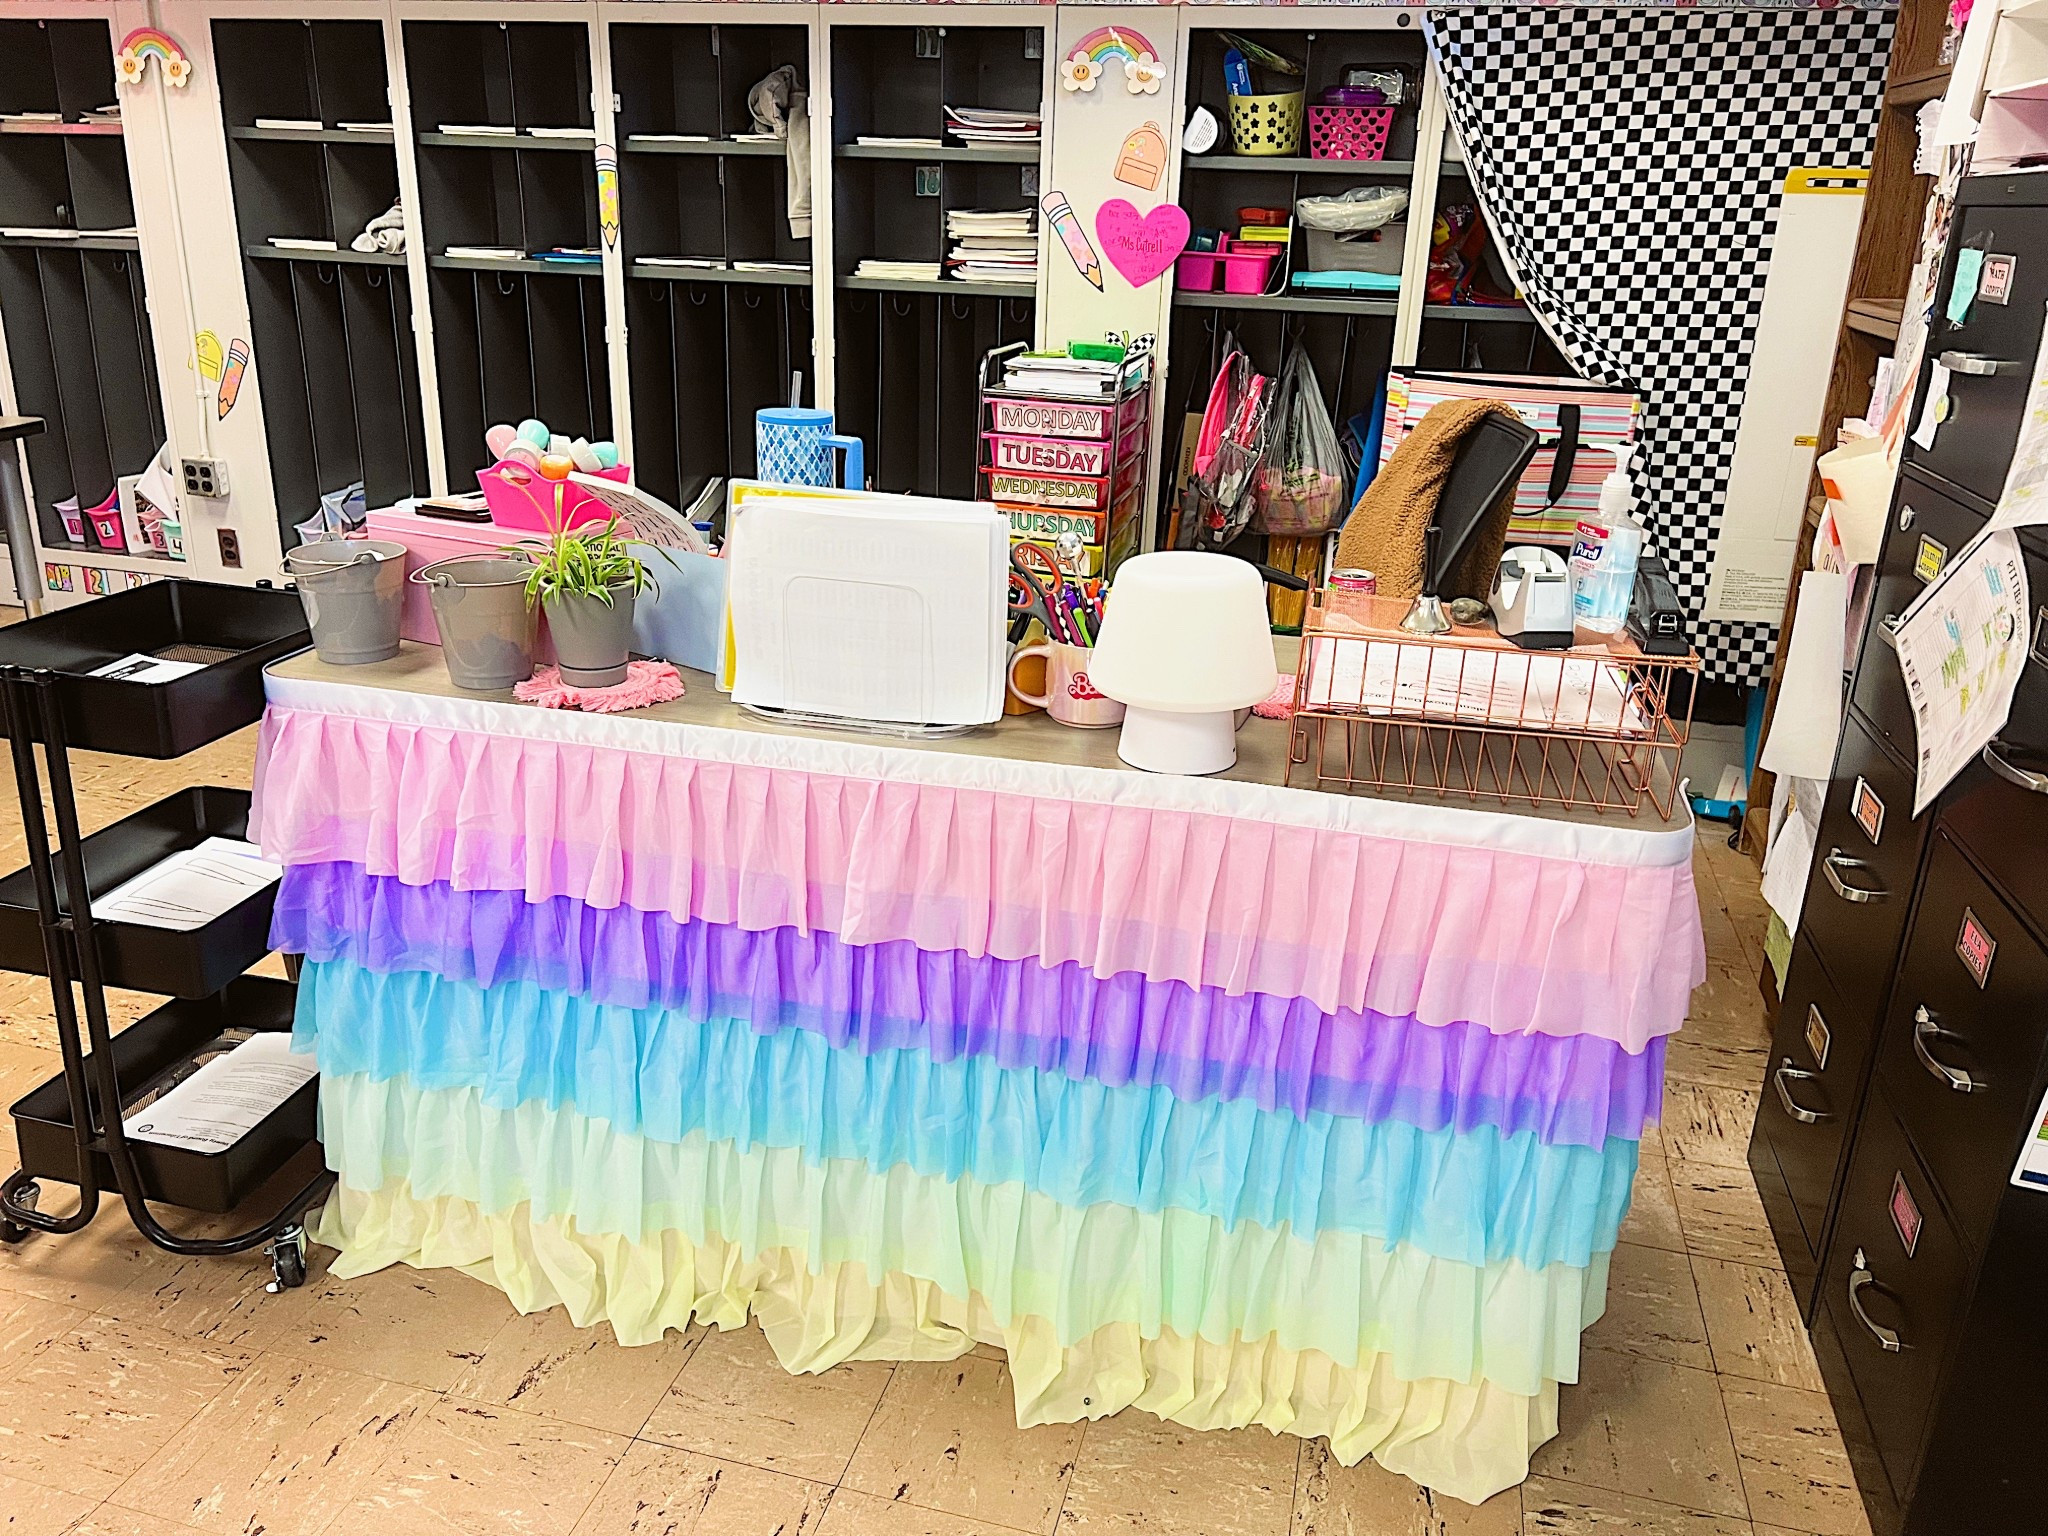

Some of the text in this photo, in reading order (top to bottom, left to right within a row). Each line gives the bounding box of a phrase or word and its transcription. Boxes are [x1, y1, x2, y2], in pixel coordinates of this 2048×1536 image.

[1001, 407, 1100, 431] MONDAY
[1002, 443, 1098, 473] TUESDAY
[992, 476, 1098, 500] WEDNESDAY
[100, 523, 111, 536] 2
[1575, 542, 1600, 560] Purell
[1970, 930, 1982, 951] ELA
[1962, 941, 1982, 972] COPIES
